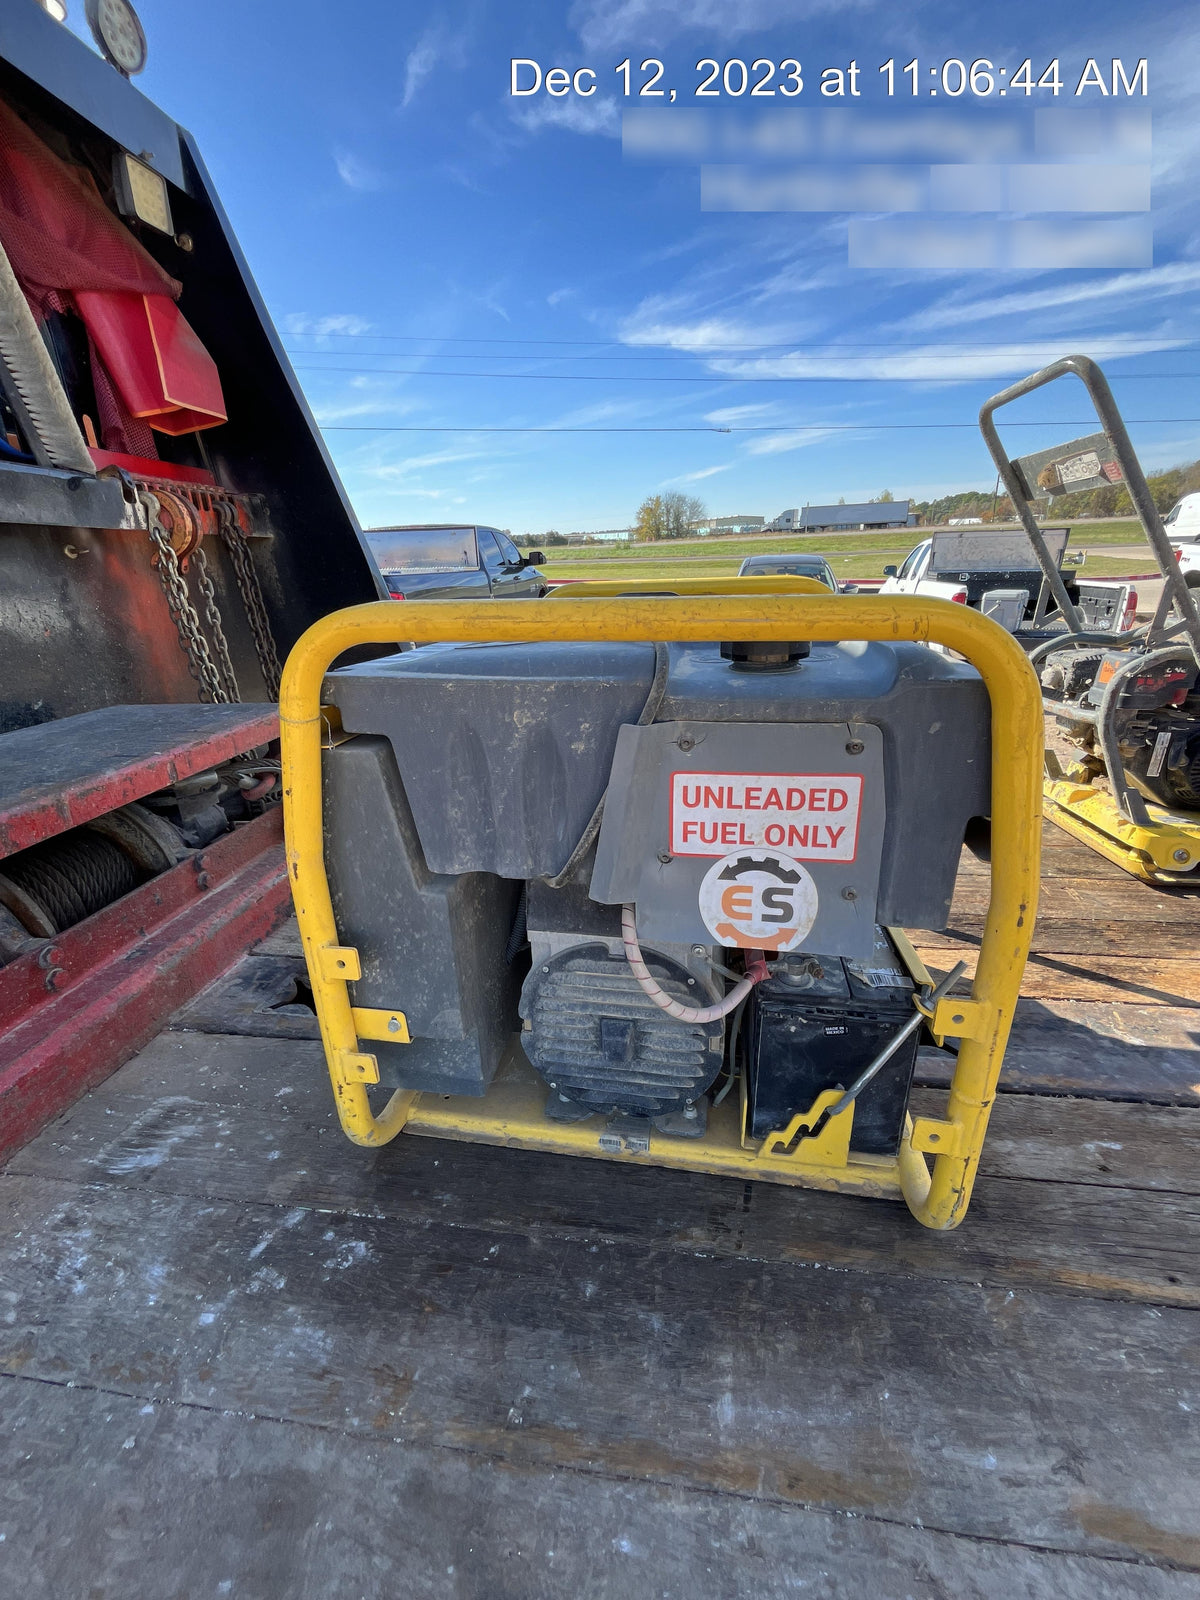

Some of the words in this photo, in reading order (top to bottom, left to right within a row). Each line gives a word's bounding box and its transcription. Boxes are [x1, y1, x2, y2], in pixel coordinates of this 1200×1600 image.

[682, 785, 849, 812] UNLEADED
[682, 821, 755, 846] FUEL
[764, 823, 847, 849] ONLY
[721, 885, 794, 923] ES
